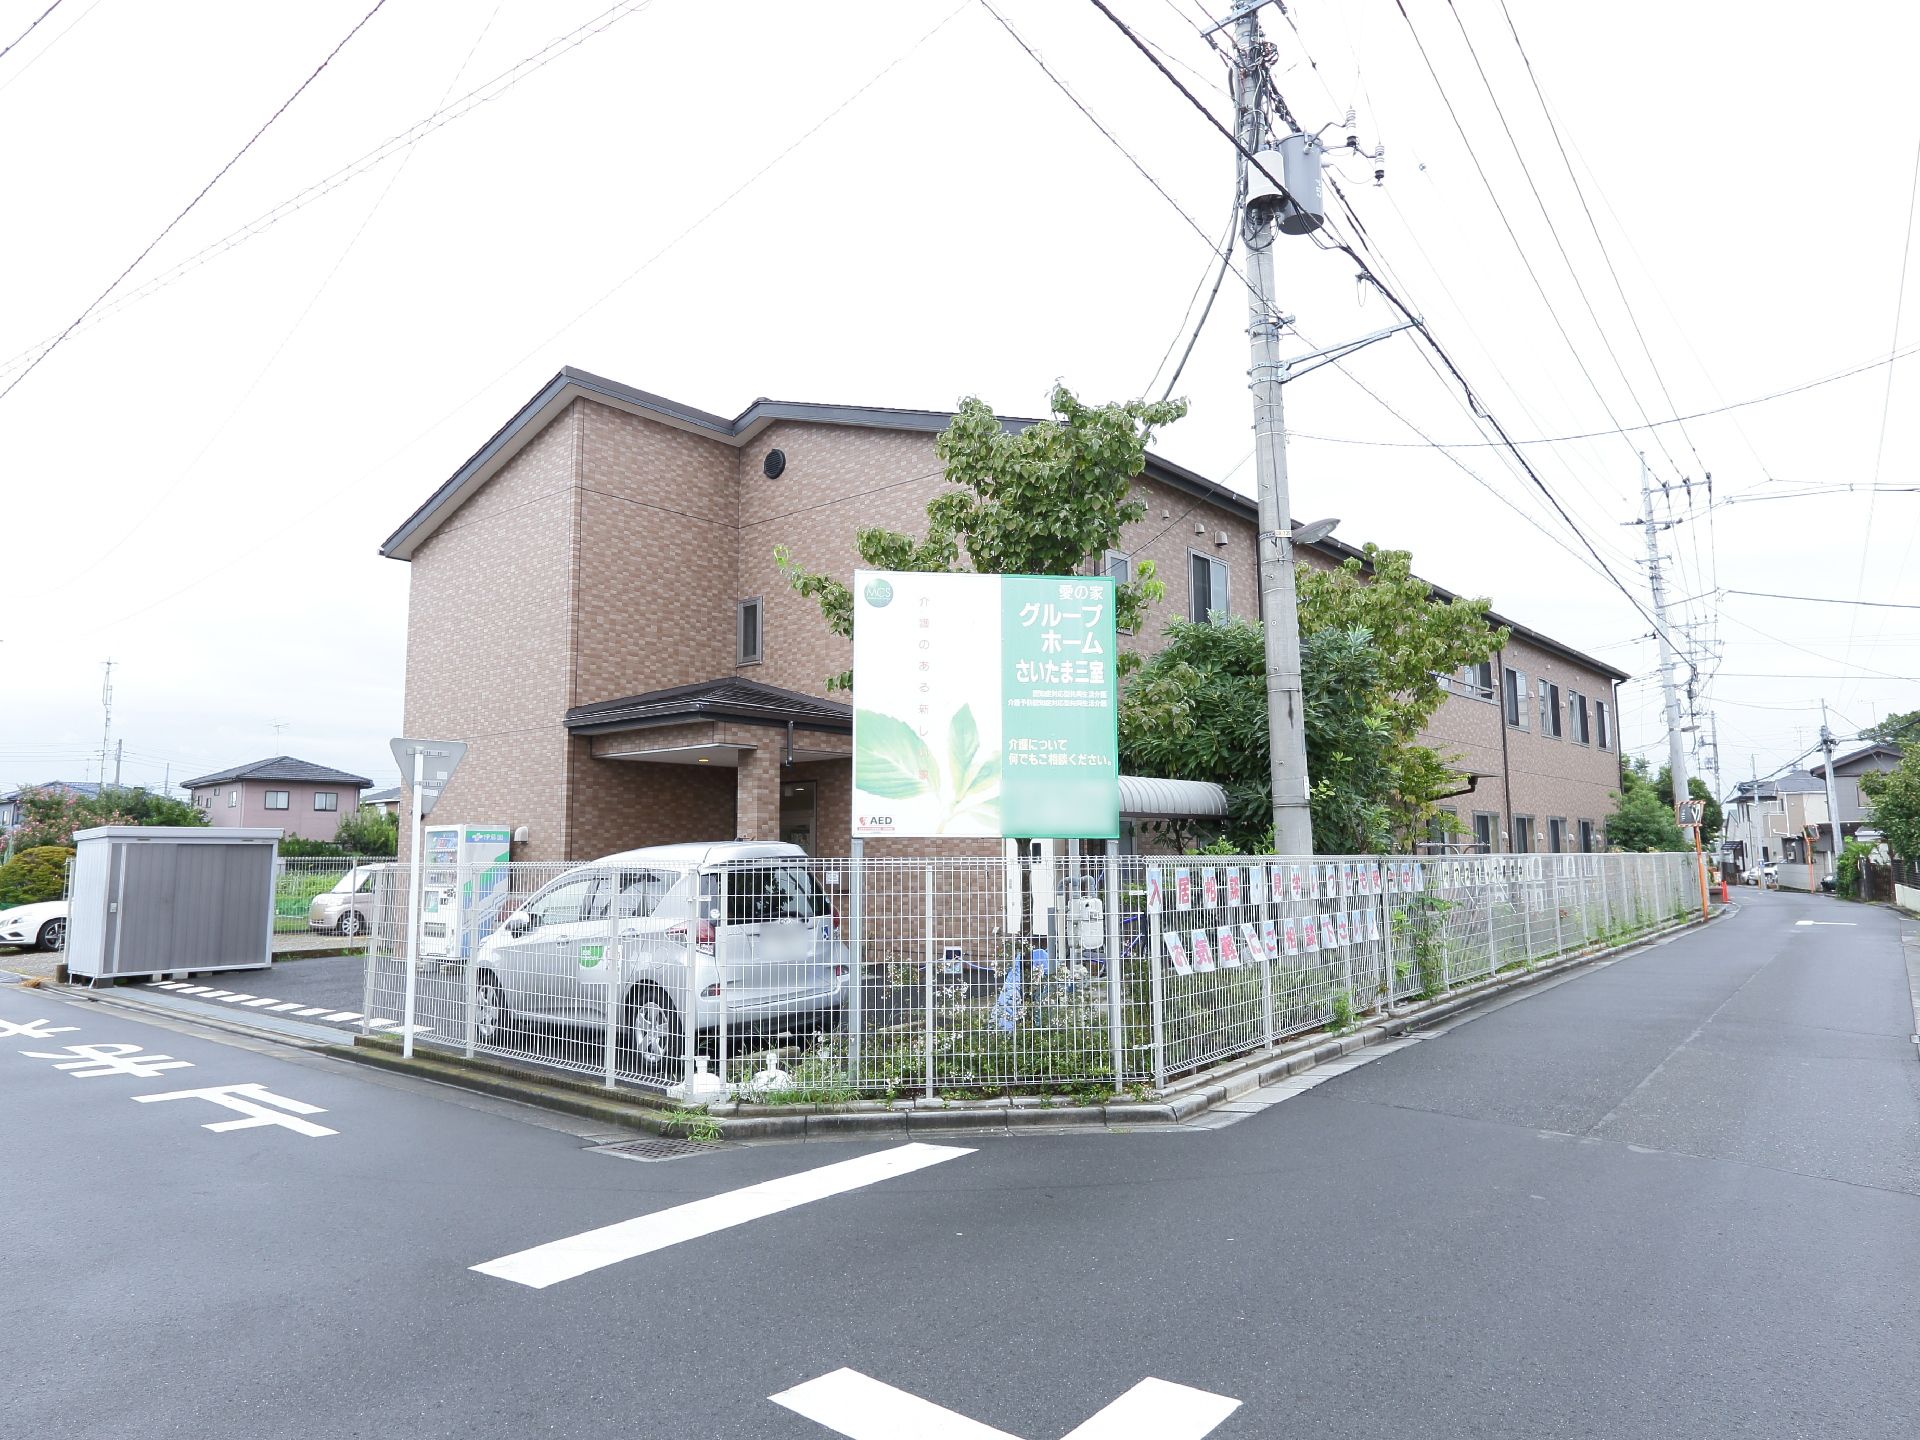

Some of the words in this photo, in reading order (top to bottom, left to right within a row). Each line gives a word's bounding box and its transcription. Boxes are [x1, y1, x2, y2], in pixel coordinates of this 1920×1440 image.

[1058, 584, 1104, 600] 愛の家
[1019, 602, 1103, 628] グループ
[1040, 629, 1104, 655] ホーム
[1016, 658, 1105, 684] さいたま三室
[1008, 738, 1068, 751] 介護について
[1008, 753, 1112, 766] 何でもご相談ください。
[870, 816, 893, 825] AED
